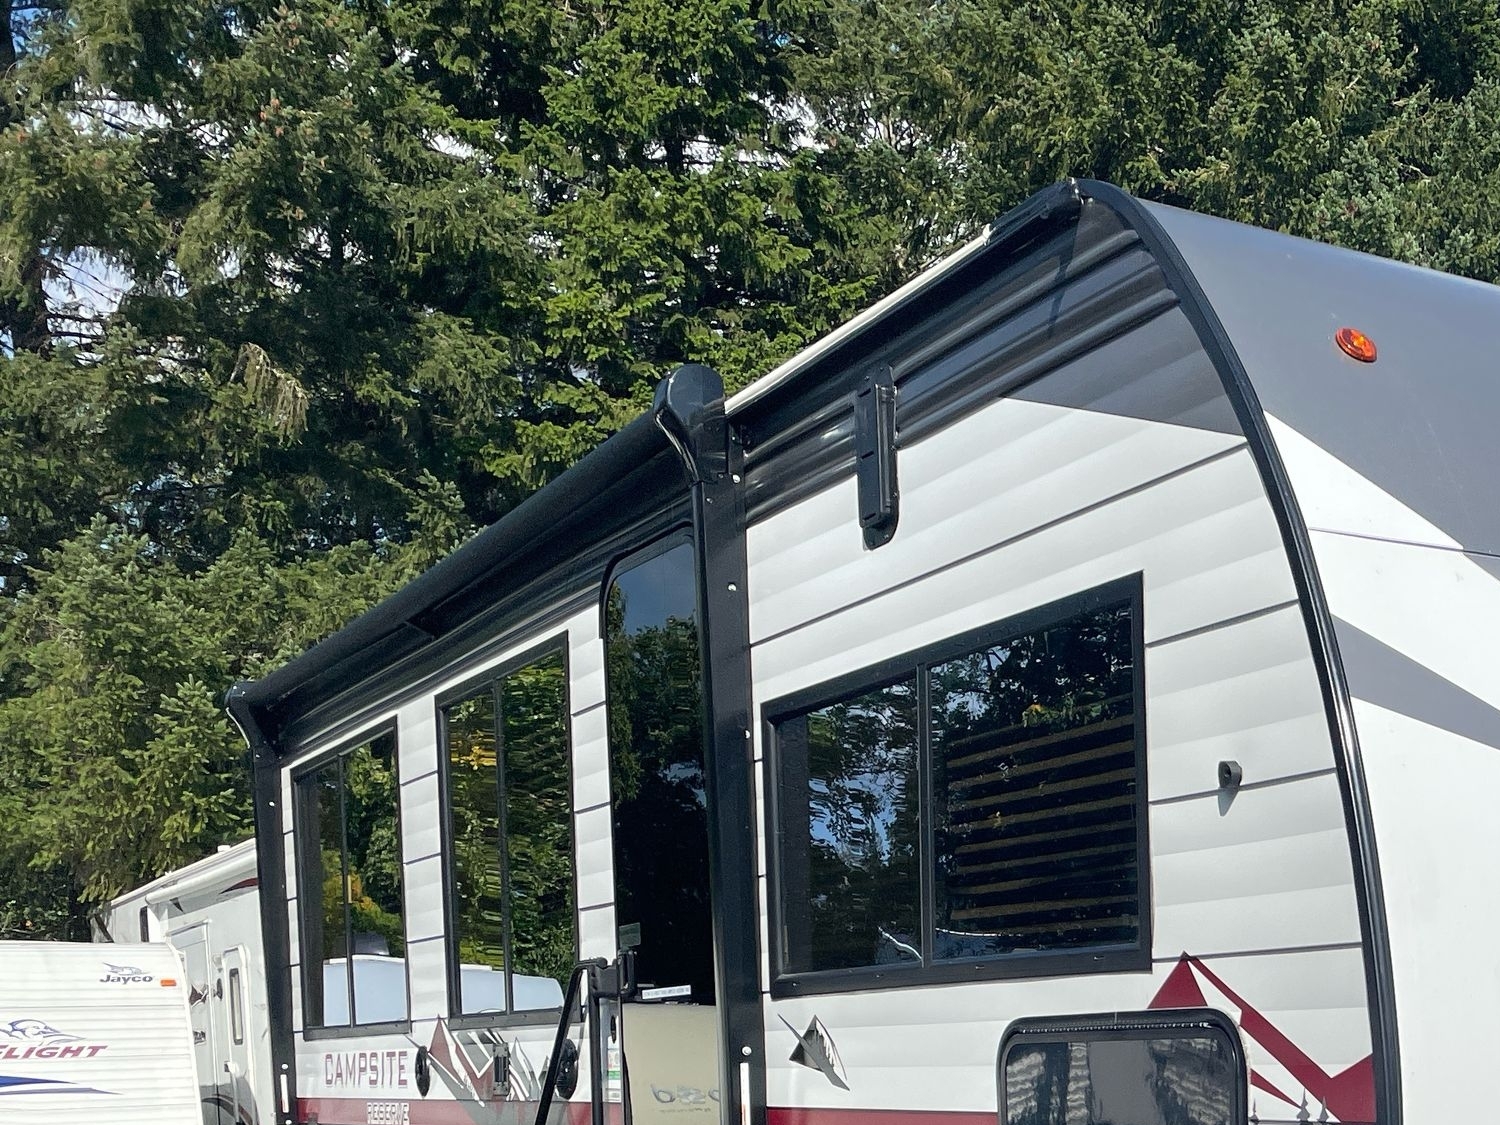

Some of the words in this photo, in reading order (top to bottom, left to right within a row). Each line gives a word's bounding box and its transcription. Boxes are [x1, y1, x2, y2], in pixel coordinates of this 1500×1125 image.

[100, 974, 153, 985] Jayco
[324, 1050, 409, 1088] CAMPSITE
[366, 1102, 410, 1125] RESERVE
